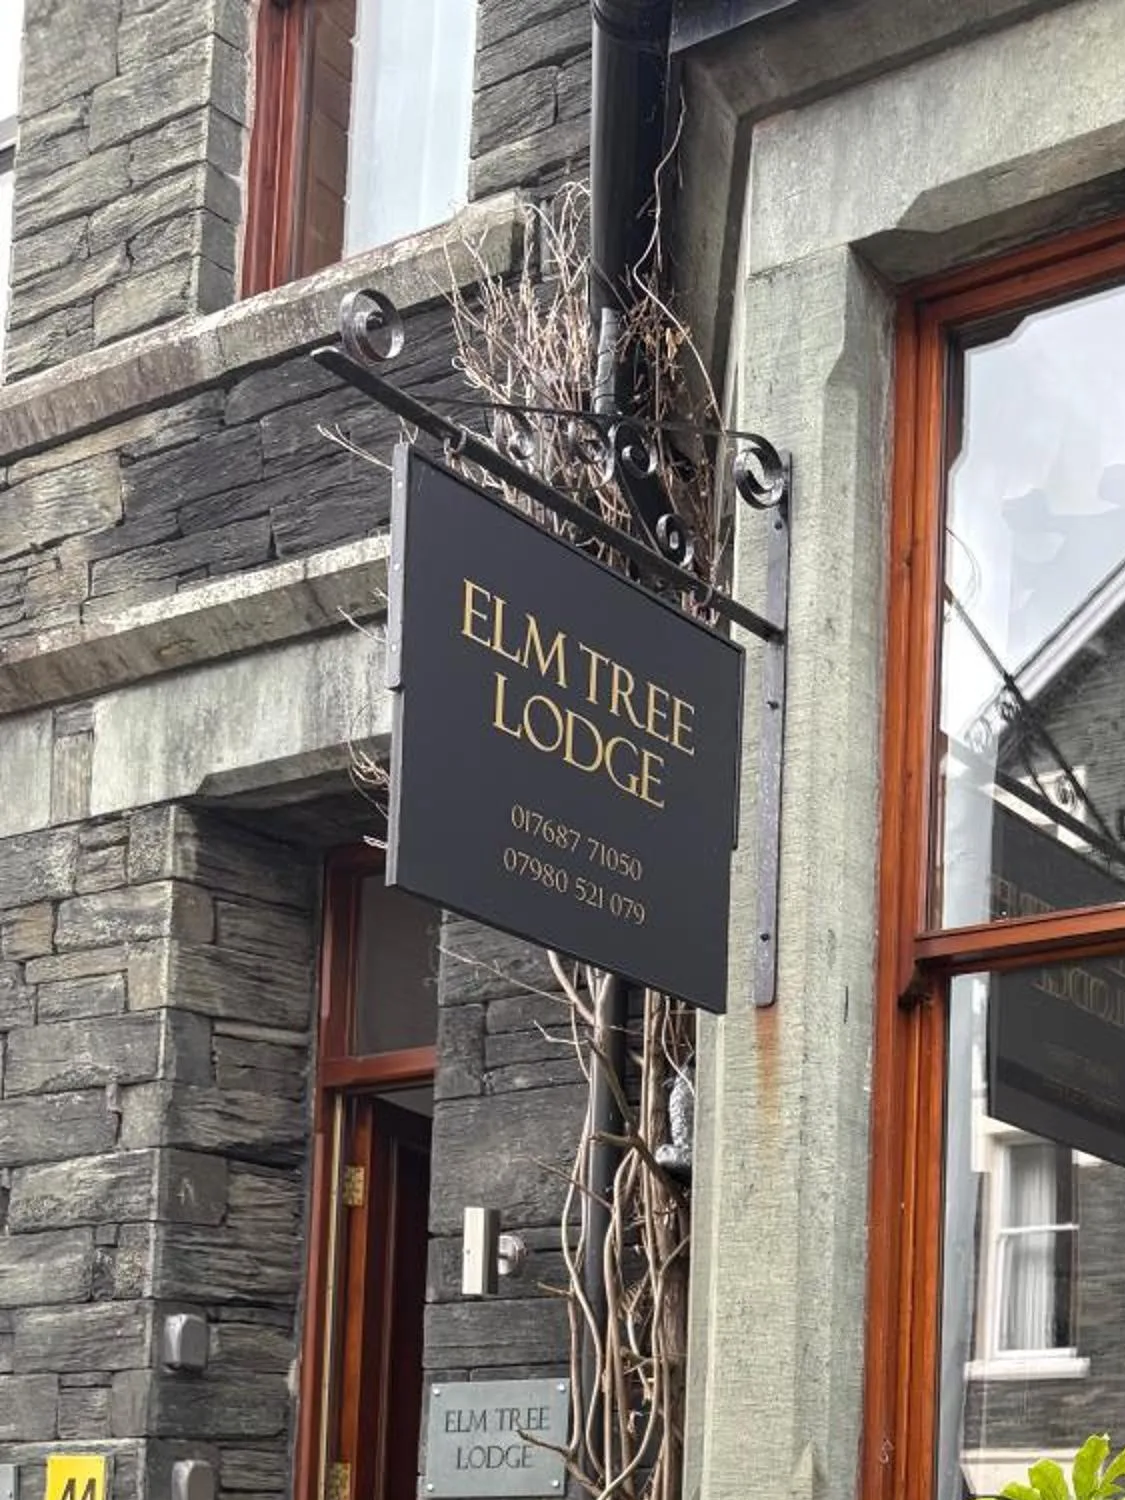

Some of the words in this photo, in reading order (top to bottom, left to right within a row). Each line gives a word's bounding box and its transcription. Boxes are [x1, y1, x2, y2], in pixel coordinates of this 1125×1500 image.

[460, 578, 567, 688] ELM
[579, 642, 695, 756] TREE
[493, 672, 665, 809] LODGE
[511, 804, 581, 854] 017687
[586, 837, 643, 882] 71050
[504, 847, 568, 893] 07980
[575, 877, 604, 909] 521
[609, 892, 646, 925] 079
[445, 1409, 487, 1433] ELM
[495, 1407, 551, 1432] TREE
[456, 1445, 533, 1470] LODGE
